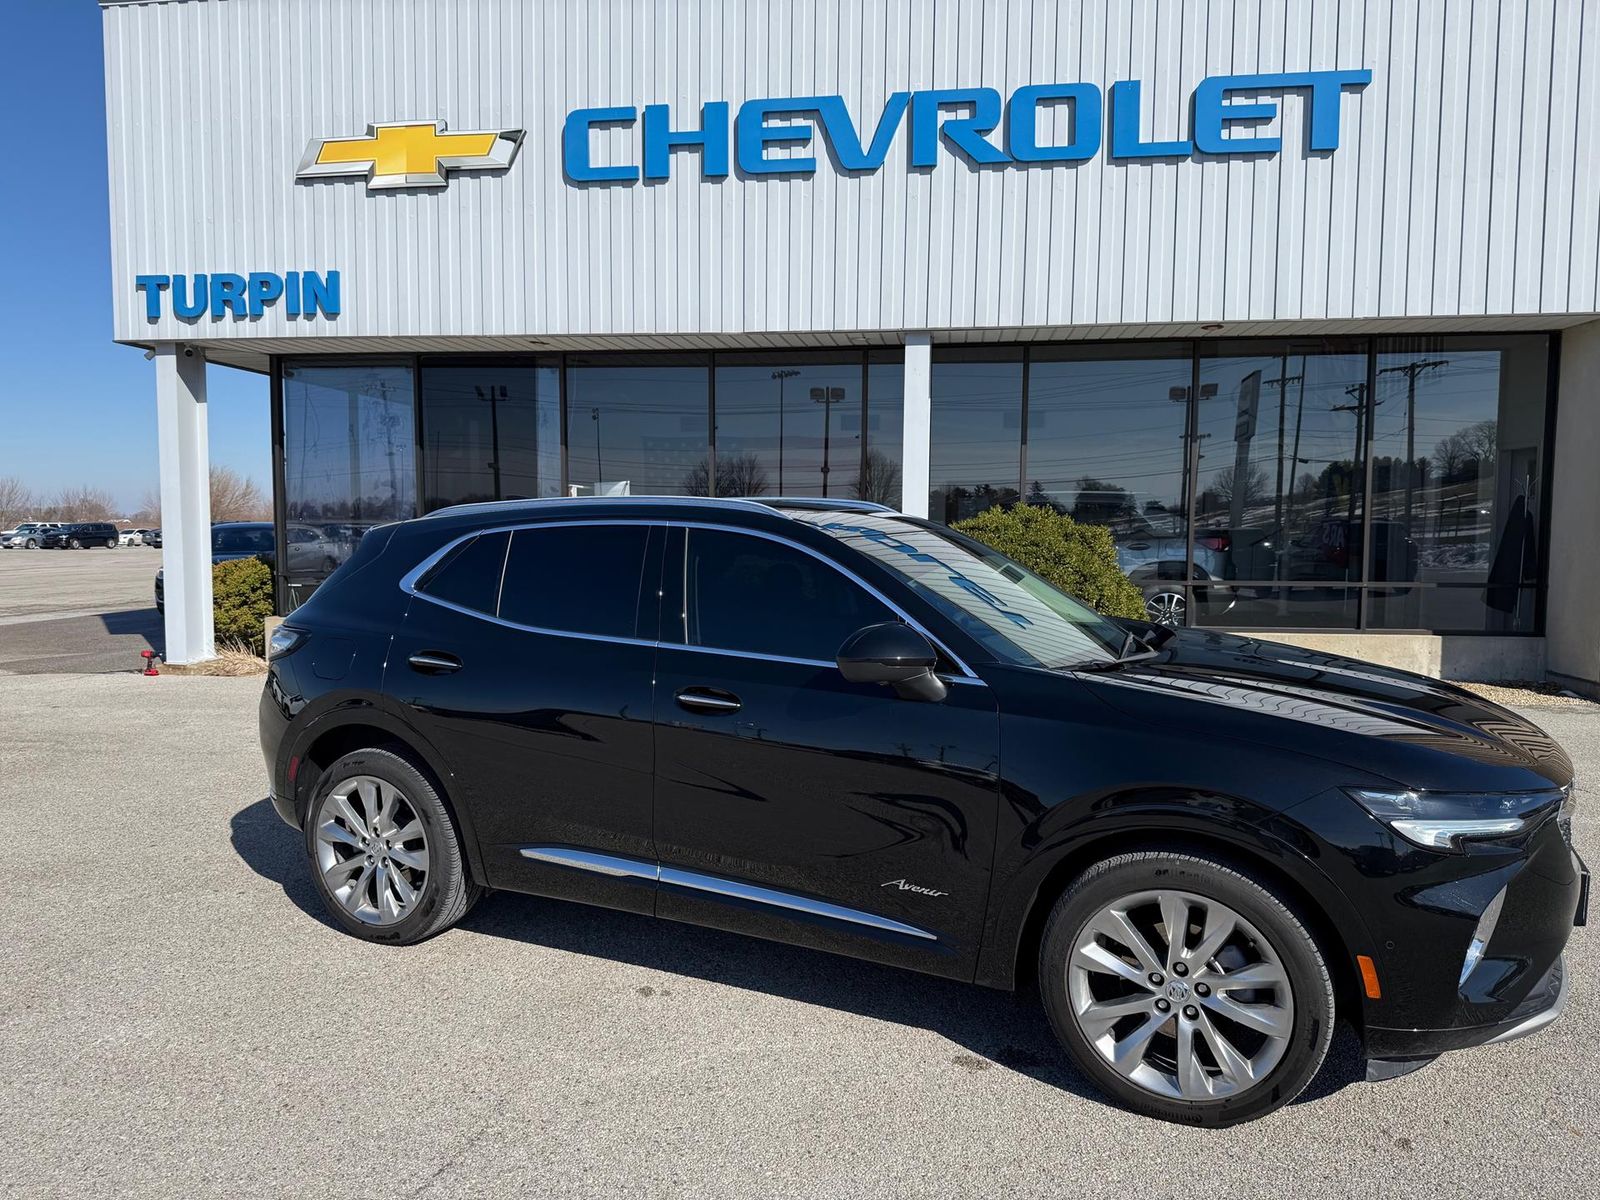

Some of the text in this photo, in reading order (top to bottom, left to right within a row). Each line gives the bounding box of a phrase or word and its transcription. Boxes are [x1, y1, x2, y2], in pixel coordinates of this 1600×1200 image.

[563, 69, 1372, 183] CHEVROLET
[136, 270, 340, 323] TURPIN
[880, 879, 949, 897] Avenir
